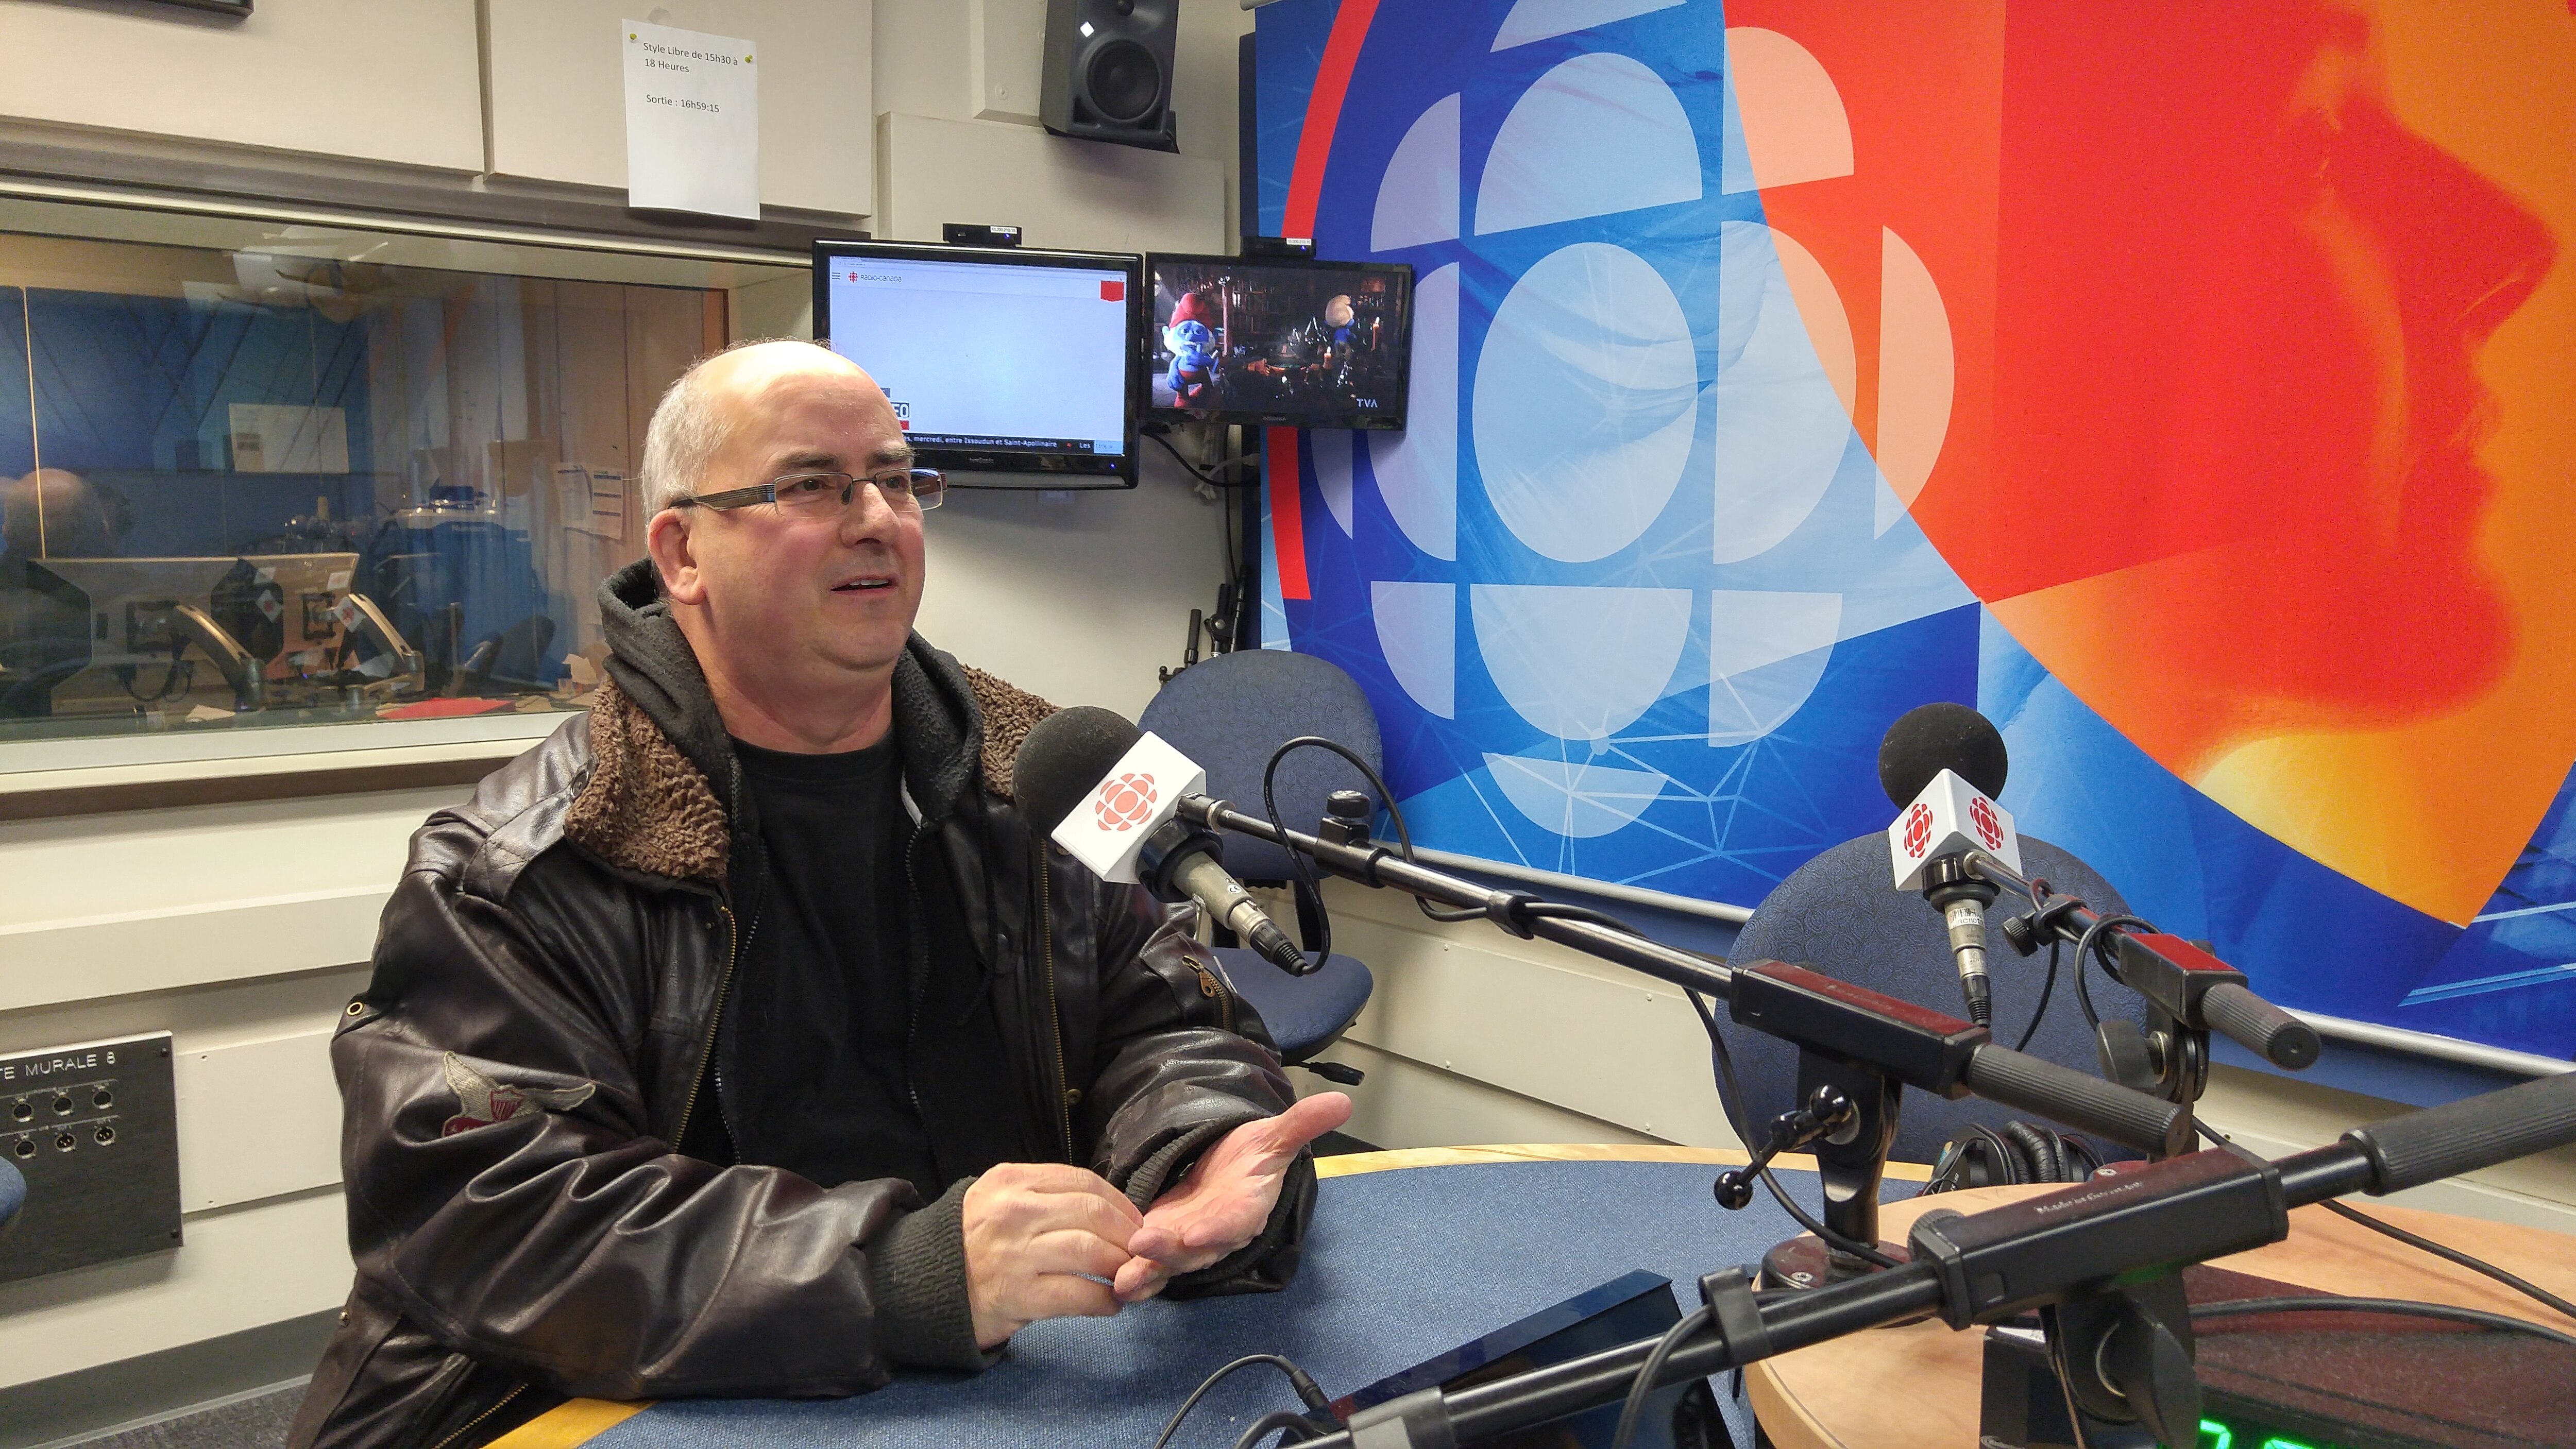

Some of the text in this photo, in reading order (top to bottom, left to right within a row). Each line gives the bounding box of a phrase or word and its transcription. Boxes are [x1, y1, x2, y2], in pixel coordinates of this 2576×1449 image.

[643, 42, 738, 65] Style Libre de 15h30 à
[645, 58, 689, 73] 18 Heures
[646, 94, 672, 106] Sortie
[680, 99, 720, 113] 16h59:15
[1356, 398, 1378, 408] TVA
[25, 1054, 97, 1077] MURALE
[106, 1051, 116, 1064] 8
